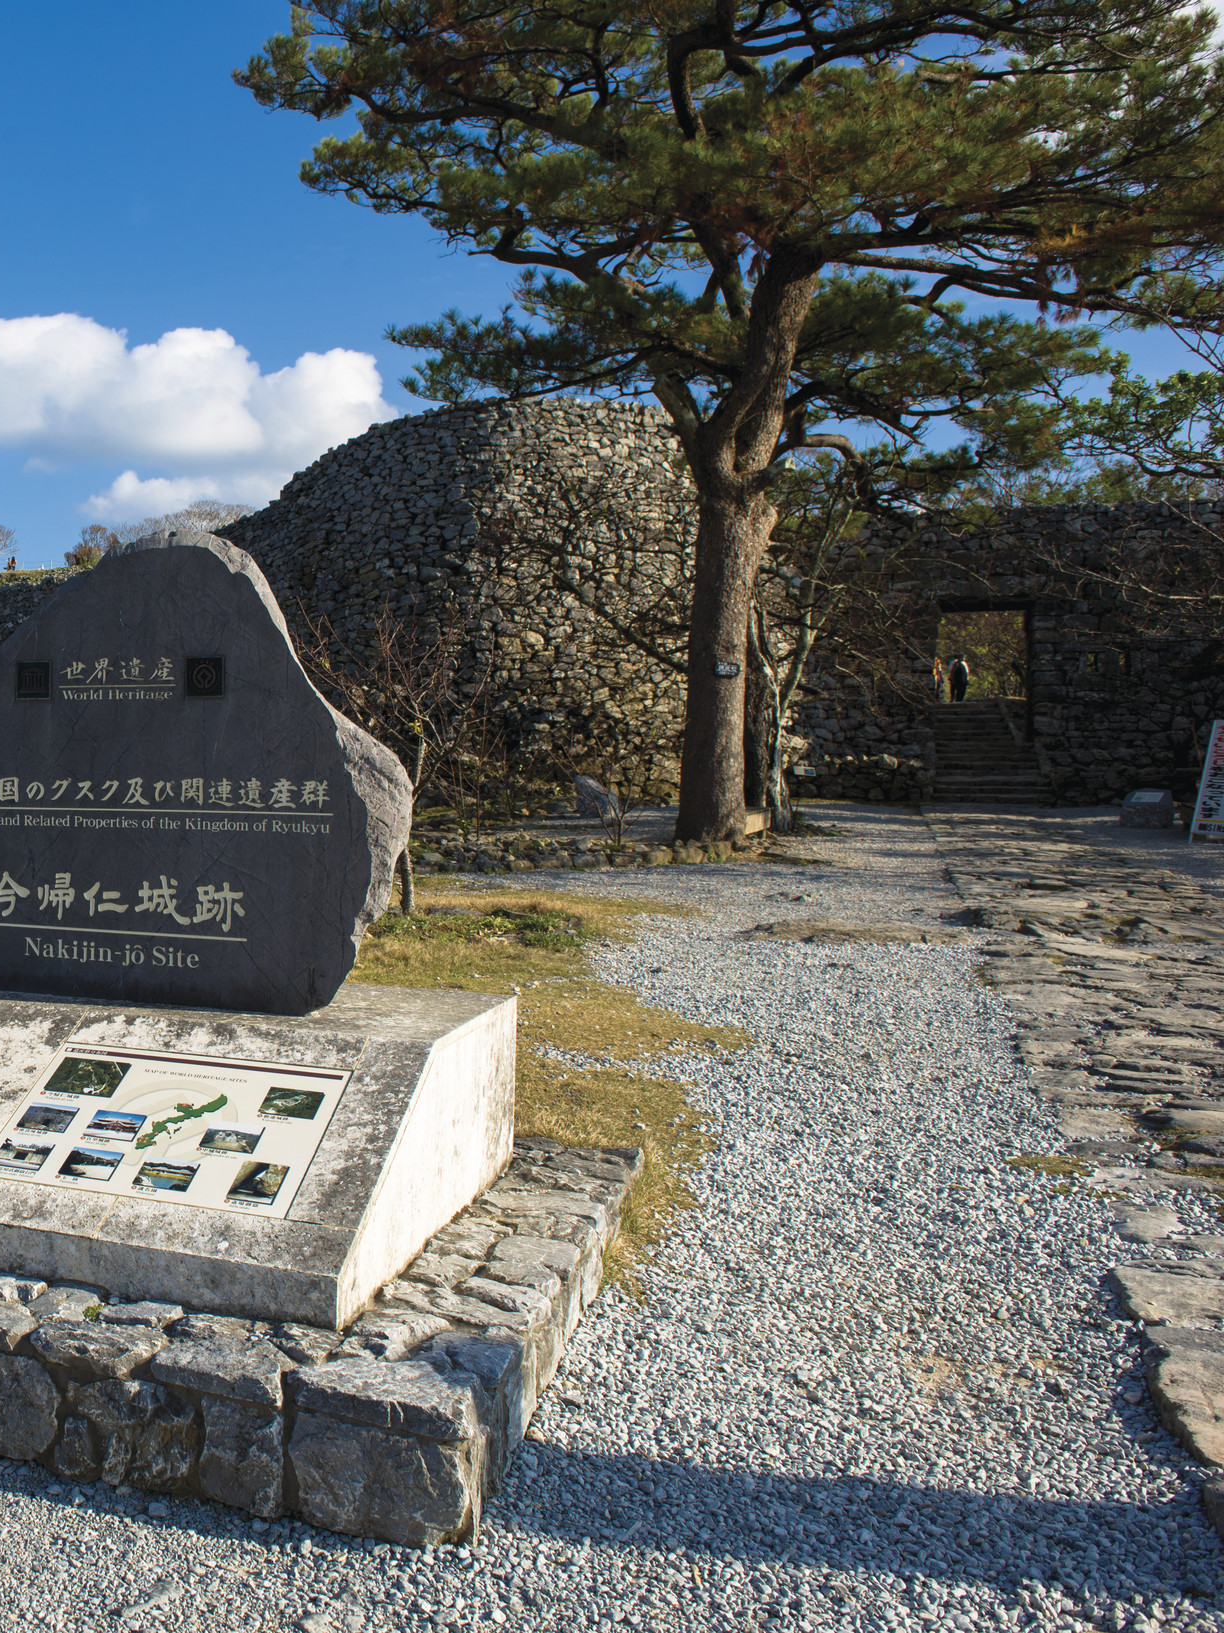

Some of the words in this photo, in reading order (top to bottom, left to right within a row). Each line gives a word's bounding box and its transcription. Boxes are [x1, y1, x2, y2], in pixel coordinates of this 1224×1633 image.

[59, 657, 175, 683] 世界遺産
[62, 689, 104, 700] World
[109, 689, 174, 700] Heritage
[24, 815, 70, 827] Related
[74, 816, 139, 829] Properties
[141, 817, 155, 829] of
[159, 817, 181, 830] the
[185, 818, 249, 832] Kingdom
[253, 819, 268, 832] of
[272, 820, 330, 835] Ryukyu
[24, 937, 145, 966] Nakijin-jô
[151, 946, 200, 968] Site
